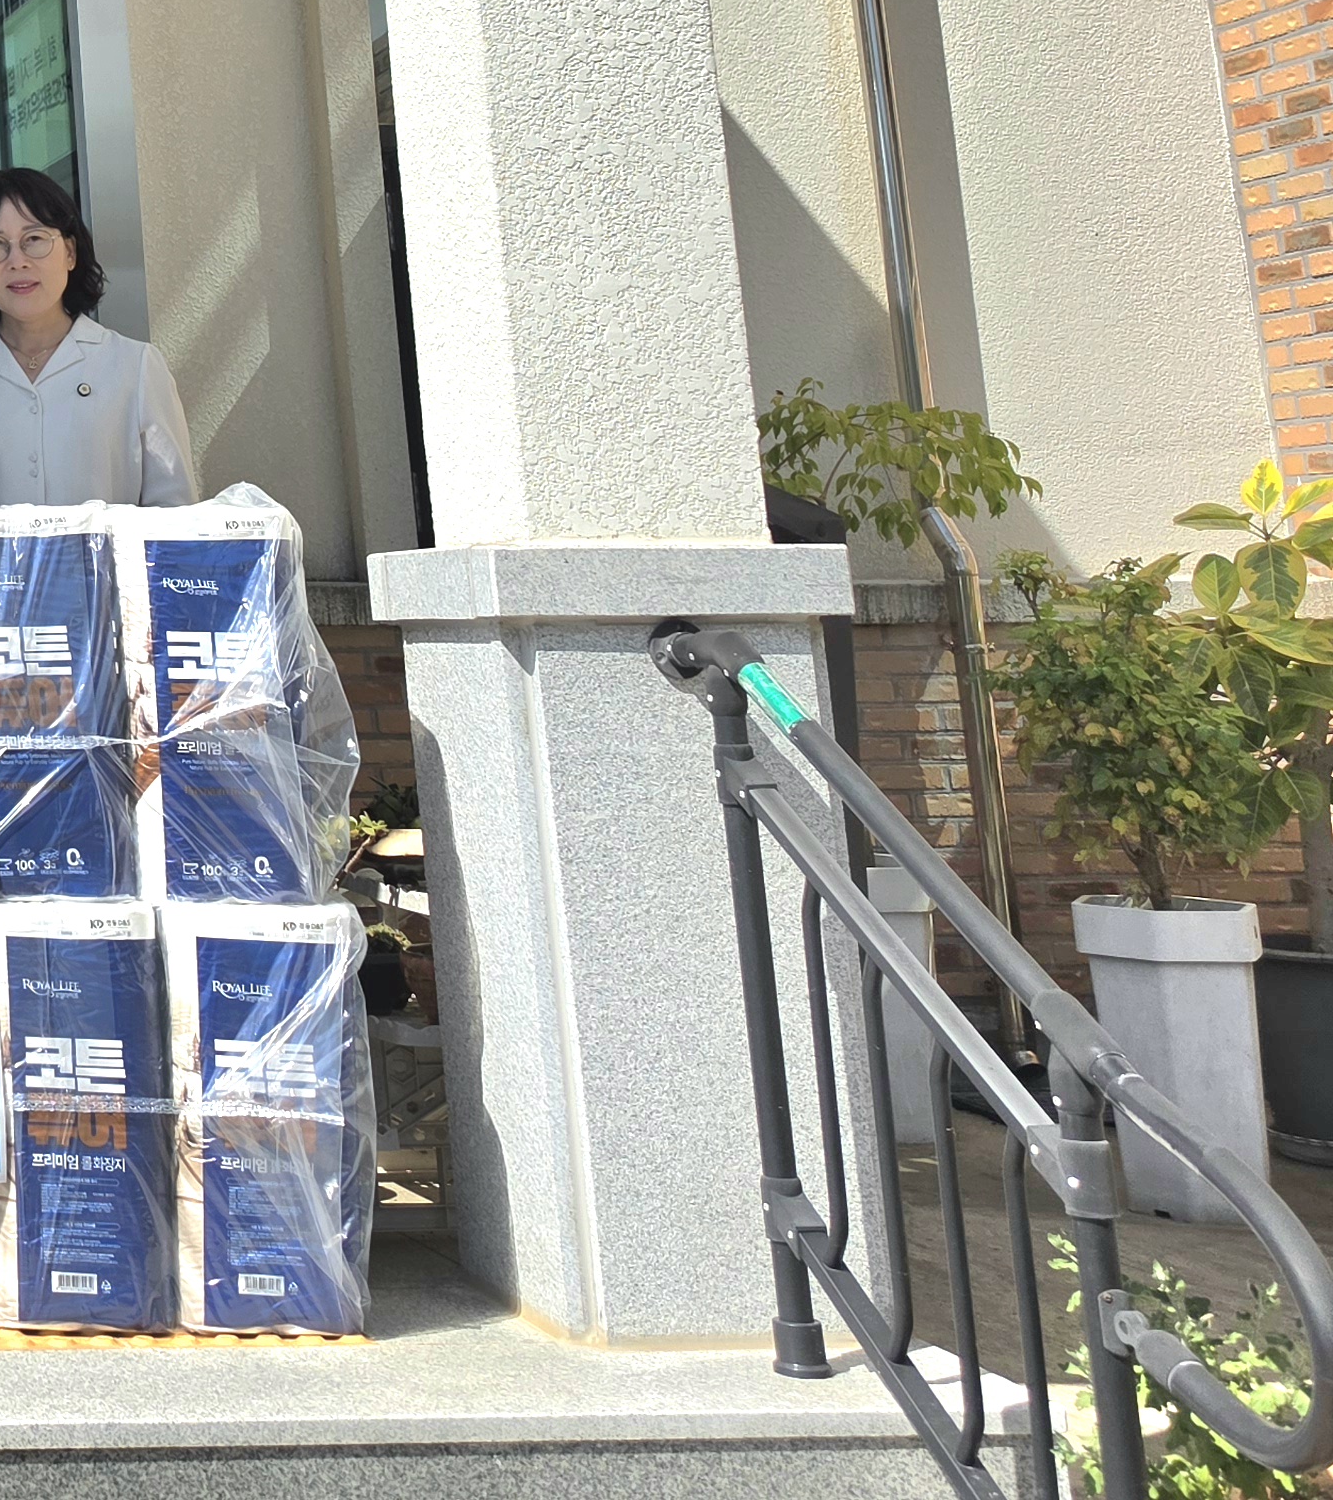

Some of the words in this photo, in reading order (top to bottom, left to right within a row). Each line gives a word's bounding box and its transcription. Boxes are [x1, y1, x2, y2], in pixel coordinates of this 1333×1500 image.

[177, 741, 221, 756] 프리미엄
[25, 1036, 126, 1094] 코튼
[32, 1153, 79, 1170] 프리미엄
[220, 1156, 267, 1174] 프리미엄
